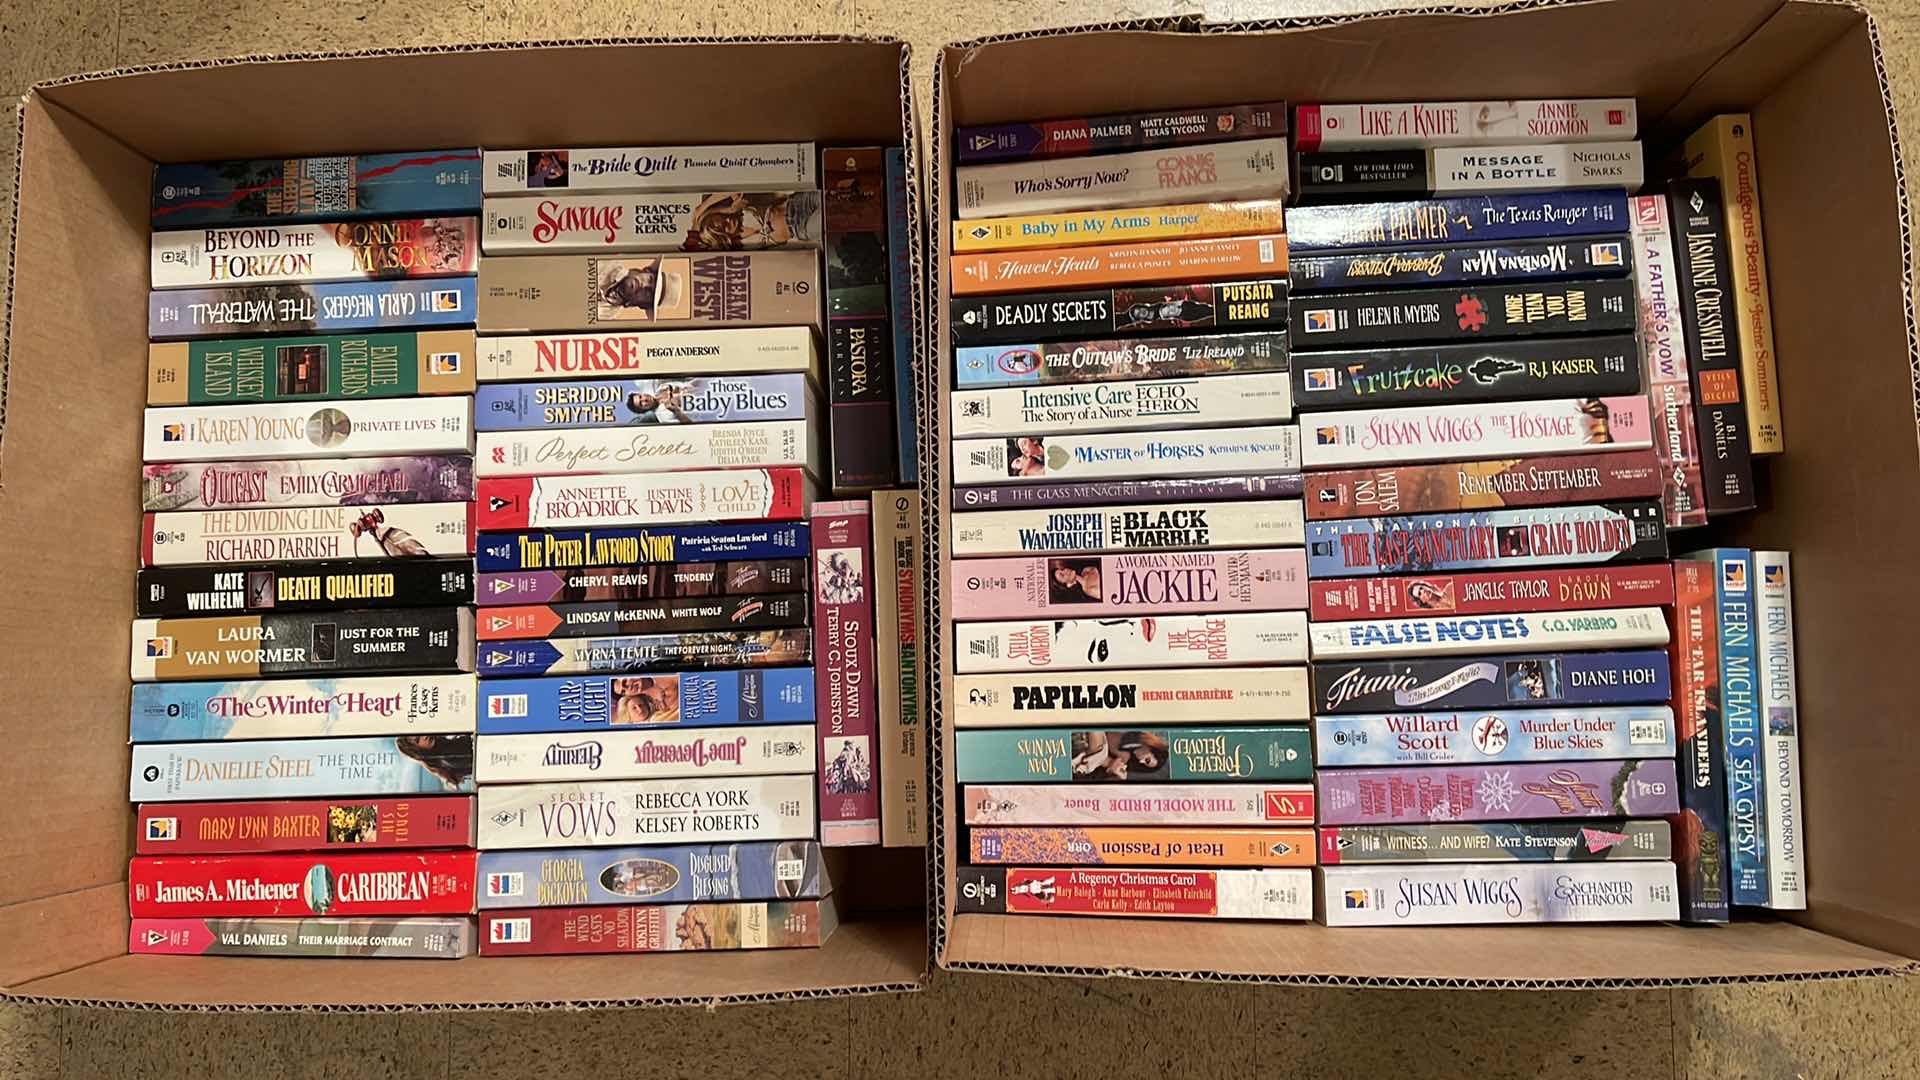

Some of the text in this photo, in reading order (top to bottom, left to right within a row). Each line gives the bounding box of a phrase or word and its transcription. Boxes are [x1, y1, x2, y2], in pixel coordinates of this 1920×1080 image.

[1360, 105, 1459, 136] LIKE A KNIFE
[1053, 124, 1132, 141] DIANA PALMER
[1144, 124, 1205, 137] TEXAS TYCOON
[1354, 162, 1414, 172] NEW YORK TIMES
[1463, 155, 1543, 166] MESSAGE
[1573, 152, 1631, 163] NICHOLAS
[1360, 171, 1407, 180] BESTSELLER
[1452, 168, 1556, 180] IN A BOTTLE
[1583, 166, 1623, 176] SPARKS
[635, 204, 690, 214] FRANCES
[533, 200, 623, 243] Savage
[635, 215, 673, 225] CASEY
[635, 224, 677, 234] KERNS
[1022, 215, 1151, 236] Baby in My Arms
[205, 230, 314, 253] BEYOND THE
[209, 254, 312, 280] HORIZON
[694, 257, 725, 321] WEST
[727, 256, 751, 321] DREAM
[1223, 284, 1274, 302] PUTSATA
[1687, 232, 1727, 361] JASMINE CRESSWELL
[189, 304, 276, 325] WATERFALL
[279, 299, 315, 320] THE
[324, 293, 415, 318] CARLA NEGGERS
[996, 300, 1106, 325] DEADLY SECRETS
[1229, 302, 1270, 320] REANG
[1506, 294, 1522, 323] MORE
[1527, 293, 1544, 322] THAN
[1548, 295, 1564, 317] YOU
[1569, 290, 1586, 321] KNOW
[1647, 248, 1673, 375] A FATHER'S VOW
[1358, 305, 1440, 326] HELEN R. MYERS
[535, 337, 640, 373] NURSE
[647, 346, 719, 357] PEGGY ANDERSON
[850, 328, 867, 396] PASTORA
[1347, 353, 1463, 396] Fruitcake
[536, 386, 623, 404] SHERIDON
[710, 380, 747, 393] Those
[1137, 385, 1186, 399] ECHO
[683, 391, 787, 418] Baby Blues
[1022, 386, 1132, 408] Intensive Care
[544, 405, 616, 423] SMYTHE
[1663, 384, 1684, 463] Sutherland
[198, 418, 304, 444] KAREN YOUNG
[353, 421, 401, 432] PRIVATE
[404, 420, 436, 430] LIVES
[1458, 466, 1601, 495] REMEMBER SEPTEMBER
[1047, 513, 1102, 531] JOSEPH
[1125, 510, 1209, 530] BLACK
[1019, 529, 1103, 550] WAMBAUGH
[1125, 529, 1209, 547] MARBLE
[206, 536, 338, 561] RICHARD PARRISH
[215, 573, 244, 590] KATE
[278, 574, 394, 600] DEATH QUALIFIED
[569, 575, 648, 587] CHERYL REAVIS
[674, 572, 714, 583] TENDERLY
[1112, 569, 1218, 605] JACKIE
[187, 591, 244, 610] WILHELM
[566, 608, 665, 624] LINDSAY McKENNA
[672, 606, 722, 617] WHITE WOLF
[218, 627, 275, 642] LAURA
[340, 627, 420, 640] JUST FOR THE
[1350, 618, 1529, 645] FALSE NOTES
[186, 648, 306, 665] VAN WORMER
[353, 641, 406, 653] SUMMER
[826, 607, 842, 734] TERRY C. JOHNSTON
[845, 620, 863, 718] SIOUX DAWN
[1571, 669, 1655, 687] DIANE HOH
[1722, 601, 1753, 747] FERN MICHAELS
[1013, 685, 1136, 710] PAPILLON
[1142, 690, 1174, 702] HENRI
[1176, 688, 1233, 701] CHARRIÈRE
[1385, 716, 1459, 732] Willard
[1520, 718, 1616, 734] Murder Under
[1398, 733, 1449, 750] Scott
[1534, 735, 1603, 749] Blue Skies
[1777, 740, 1790, 787] BEYOND
[1734, 758, 1751, 795] SEA
[636, 790, 749, 809] REBECCA YORK
[1064, 798, 1100, 812] Bauer
[1109, 799, 1235, 812] THE MODEL BRIDE
[199, 816, 320, 840] MARY LYNN BAXTER
[539, 801, 616, 837] VOWS
[636, 815, 759, 834] KELSEY ROBERTS
[1737, 797, 1755, 856] GYPSY
[1779, 789, 1794, 862] TOMORROW
[1101, 843, 1224, 858] Heat of Passion
[1495, 834, 1578, 848] KATE STEVENSON
[338, 872, 430, 903] CARIBBEAN
[1078, 874, 1117, 886] Regency
[1119, 874, 1166, 884] Christmas
[1169, 875, 1196, 885] Carol
[155, 878, 300, 903] James A. Michener
[1395, 877, 1523, 919] SUSAN WIGGS
[222, 934, 287, 946] VAL DANIELS
[299, 935, 322, 945] THEIR
[324, 935, 366, 946] MARRIAGE
[369, 936, 413, 946] CONTRACT
